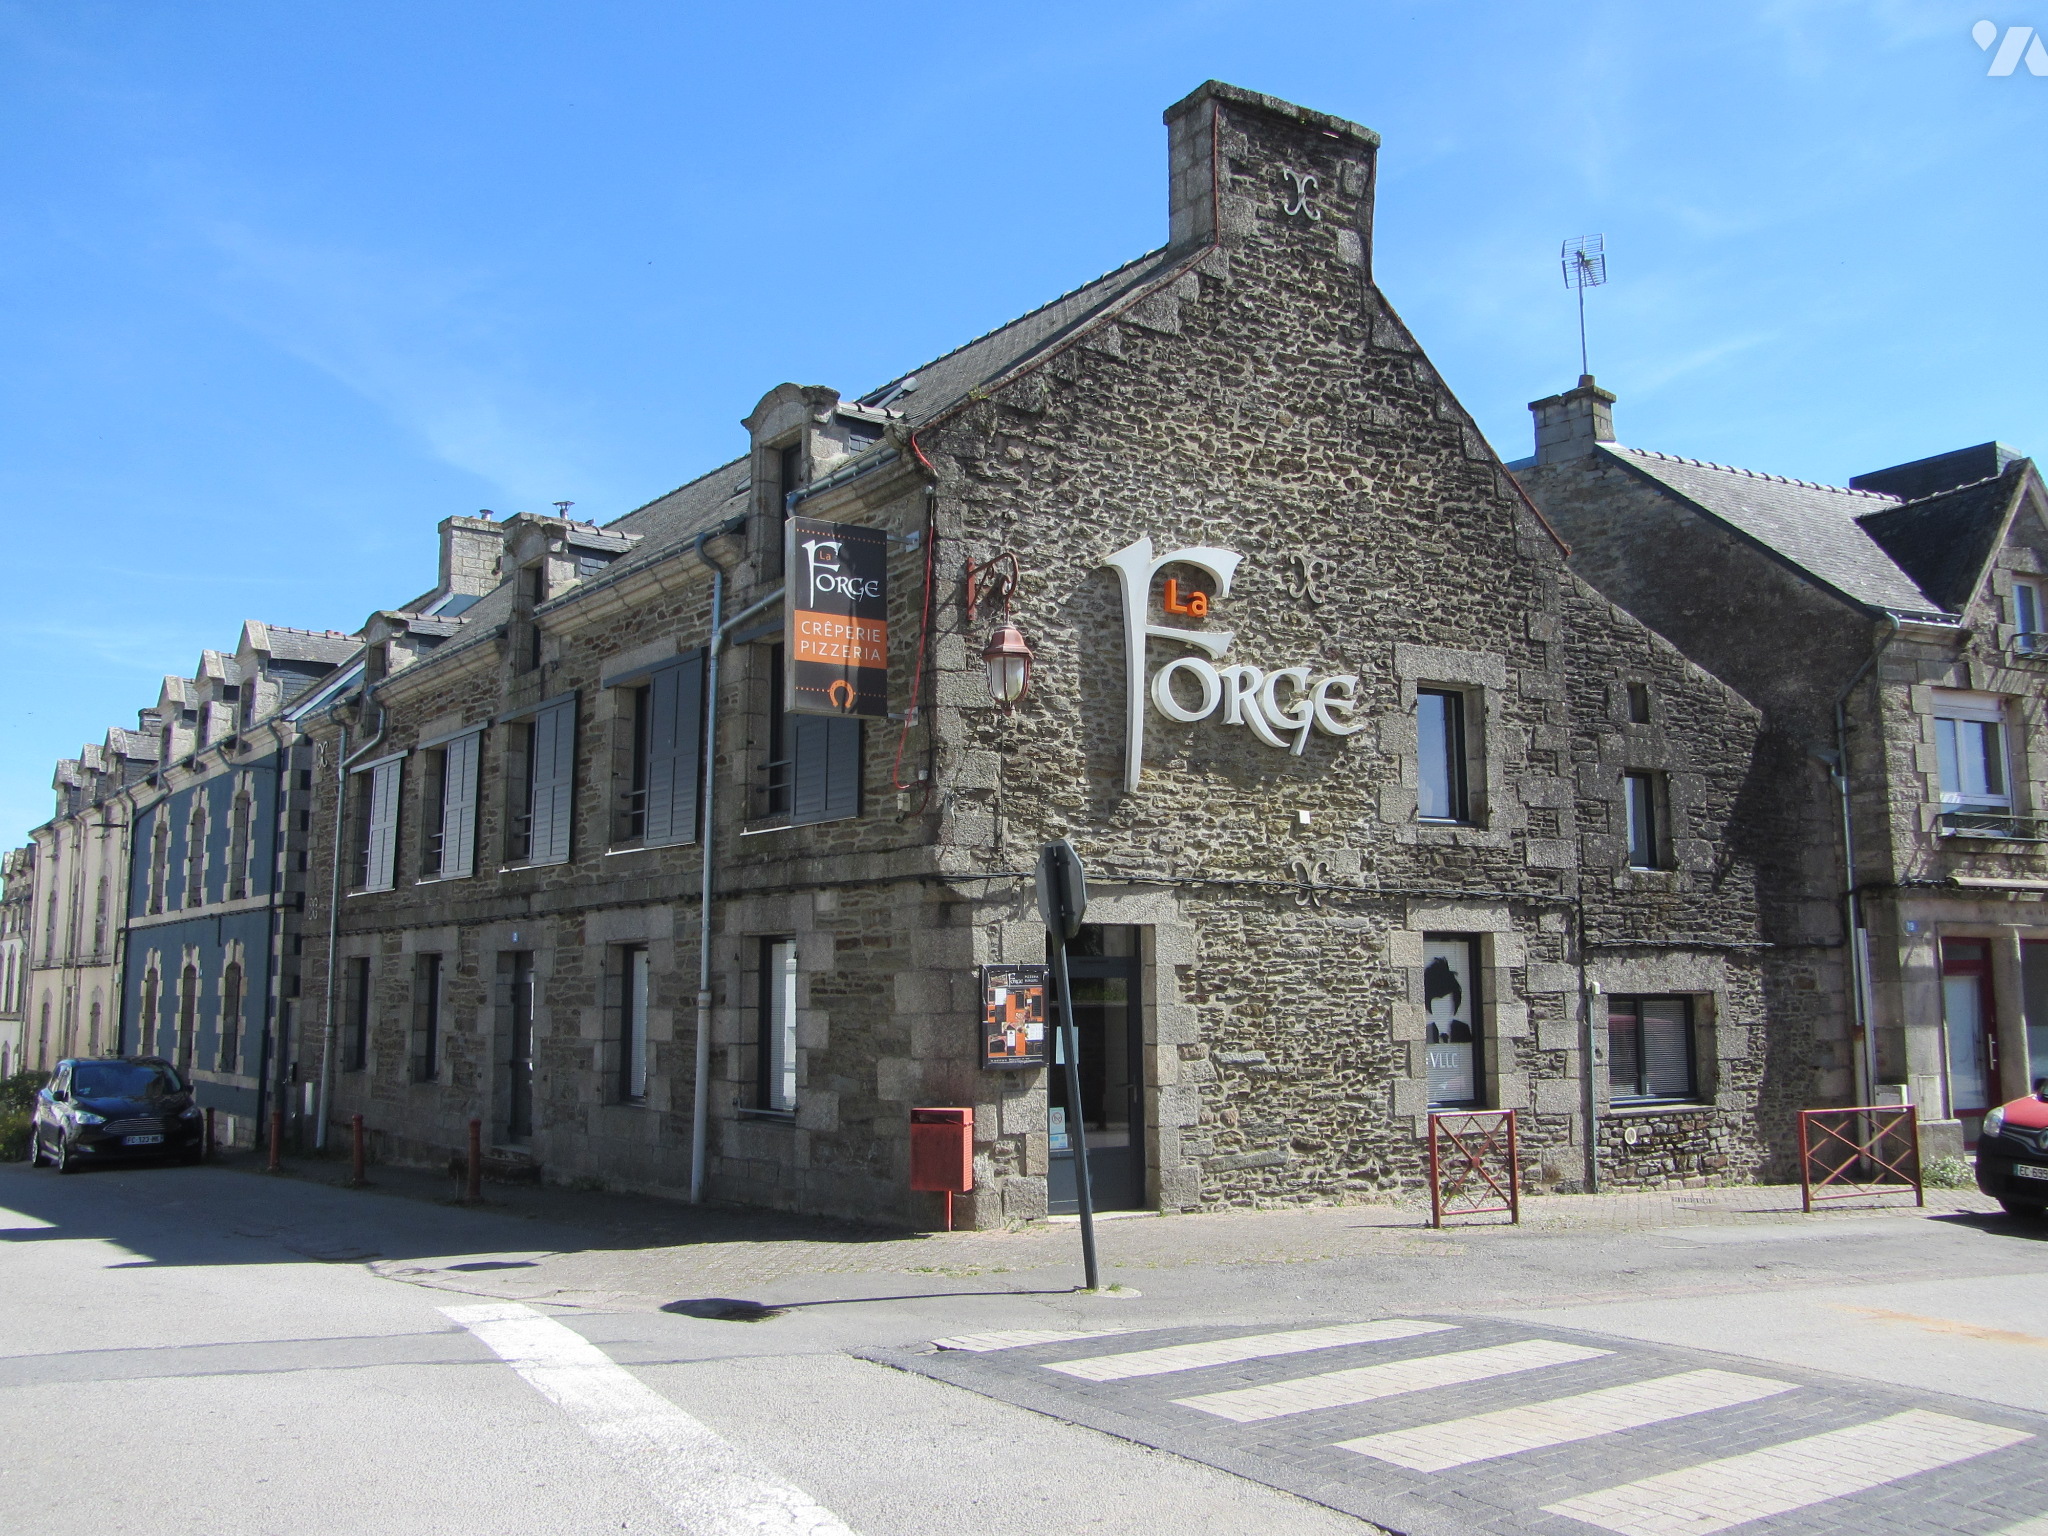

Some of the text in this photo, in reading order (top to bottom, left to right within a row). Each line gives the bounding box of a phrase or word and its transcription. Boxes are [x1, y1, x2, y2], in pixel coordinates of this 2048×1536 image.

[819, 550, 832, 561] La
[801, 539, 881, 609] FORGE
[1164, 578, 1208, 617] La
[801, 620, 881, 643] CRÊPERIE
[800, 640, 881, 661] PIZZERIA
[1105, 537, 1364, 792] FORGE
